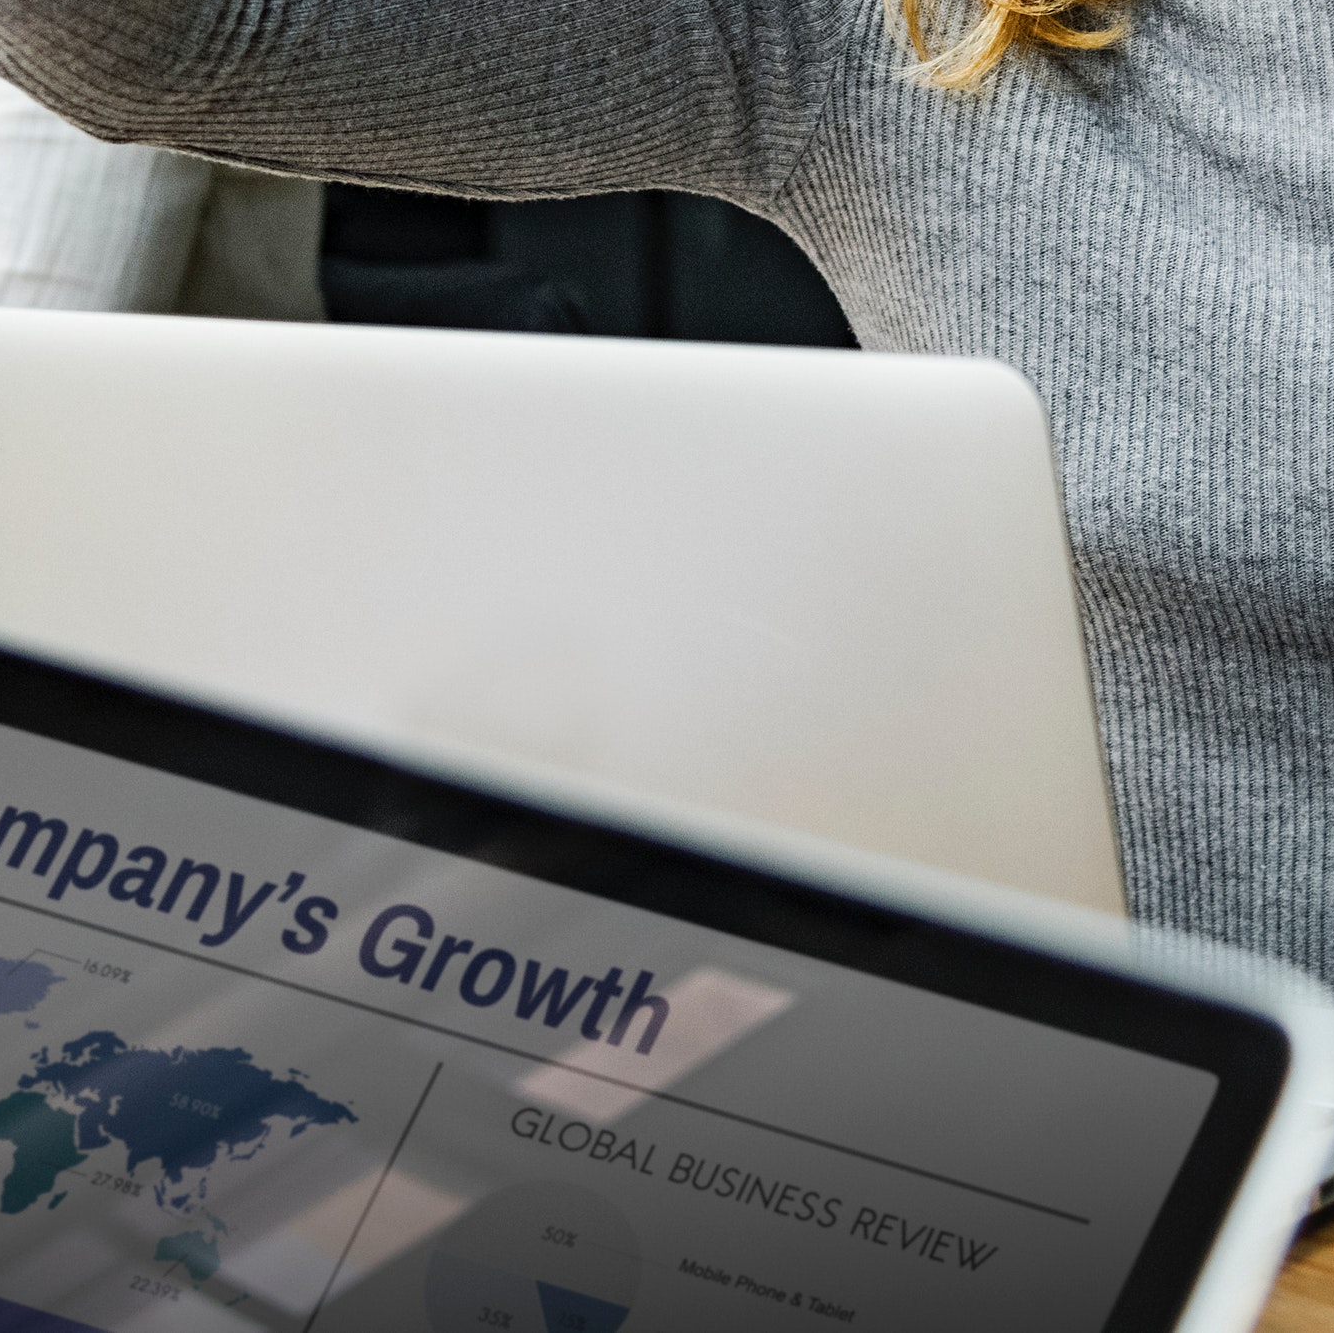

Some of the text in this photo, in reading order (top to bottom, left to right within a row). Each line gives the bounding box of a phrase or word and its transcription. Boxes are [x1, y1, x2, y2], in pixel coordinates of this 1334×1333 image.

[82, 958, 133, 984] 16.09%
[359, 904, 670, 1056] Growth
[510, 1106, 999, 1271] GLOBAL BUSINESS REVIEW
[541, 1226, 578, 1249] 50%
[678, 1258, 856, 1323] Mobile Phone & Tablet
[477, 1307, 514, 1330] 35%
